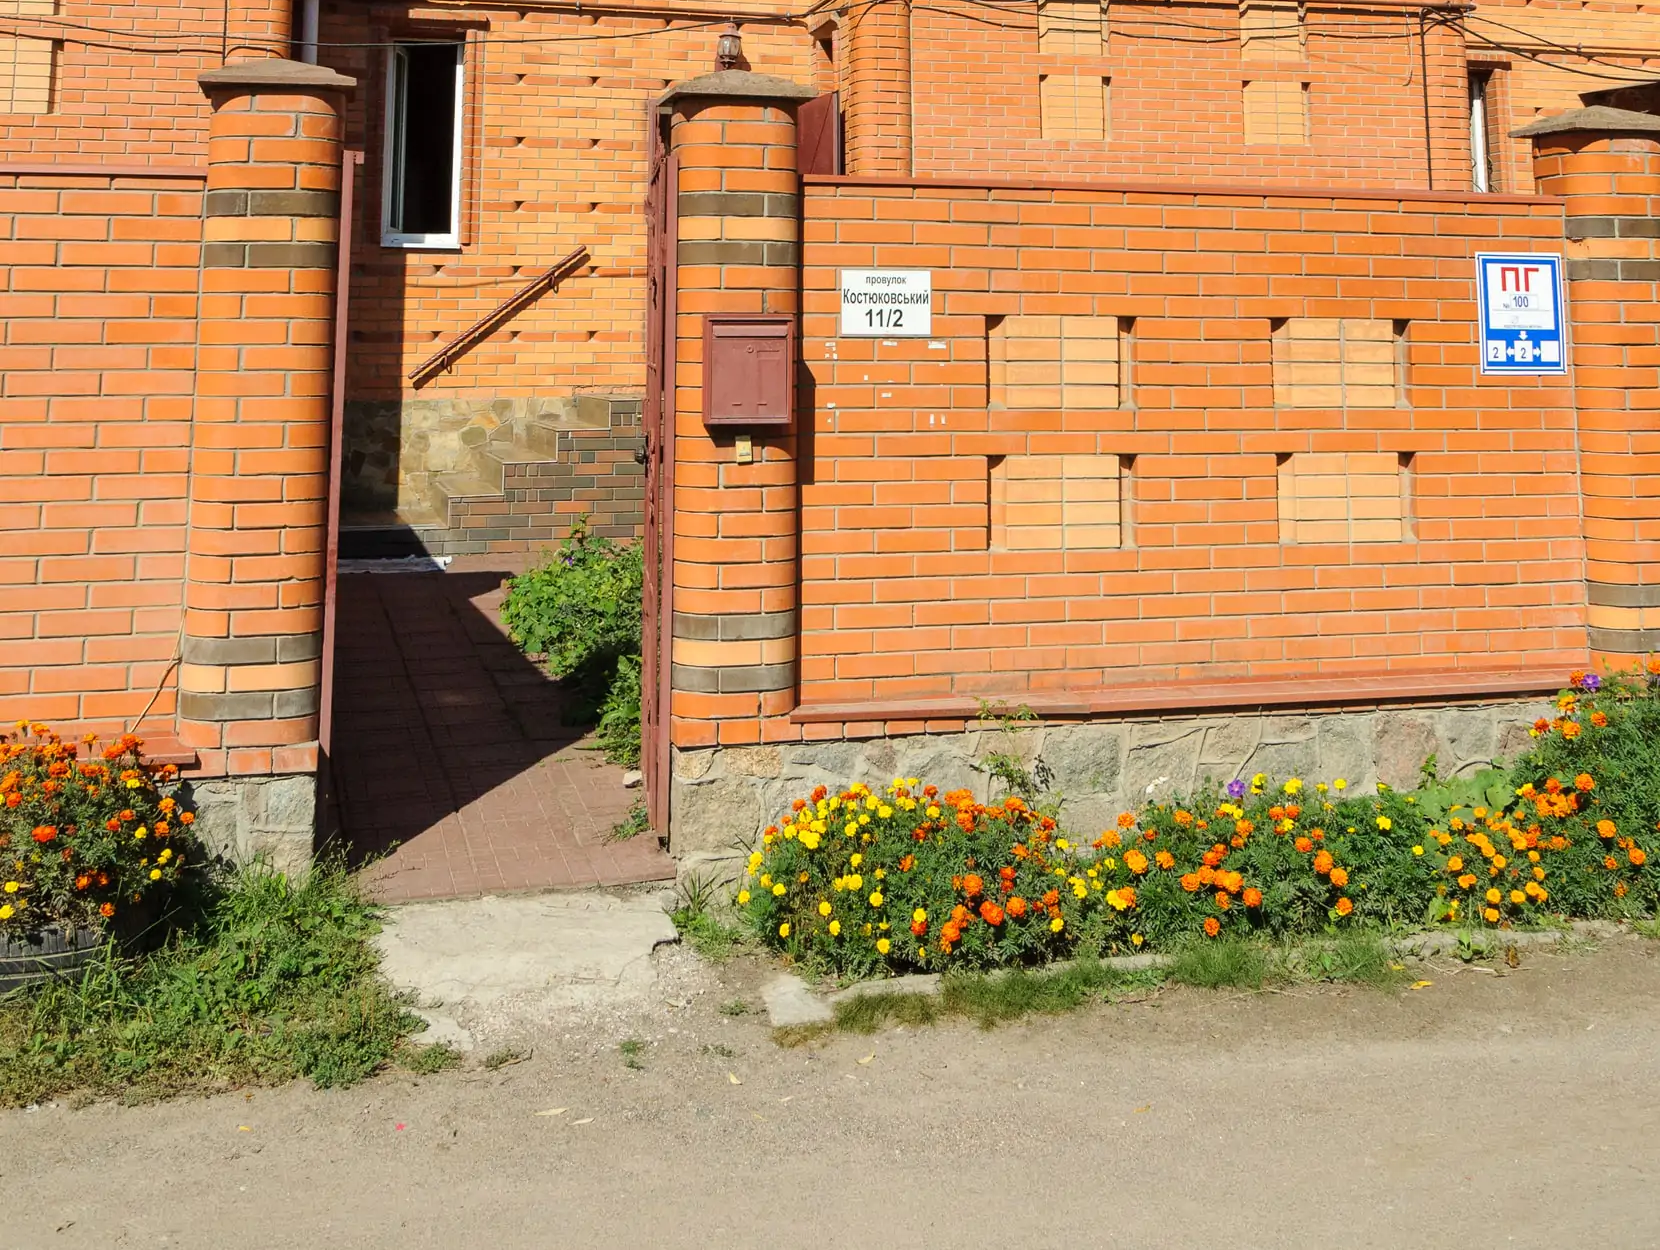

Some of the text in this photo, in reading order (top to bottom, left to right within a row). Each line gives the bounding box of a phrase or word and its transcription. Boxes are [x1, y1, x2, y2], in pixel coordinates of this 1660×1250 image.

[865, 276, 907, 286] провулок
[1501, 267, 1539, 292] ПГ
[843, 288, 929, 304] Костюковський
[1512, 296, 1529, 308] 100
[865, 309, 903, 327] 11/2
[1493, 347, 1527, 359] 2 2
